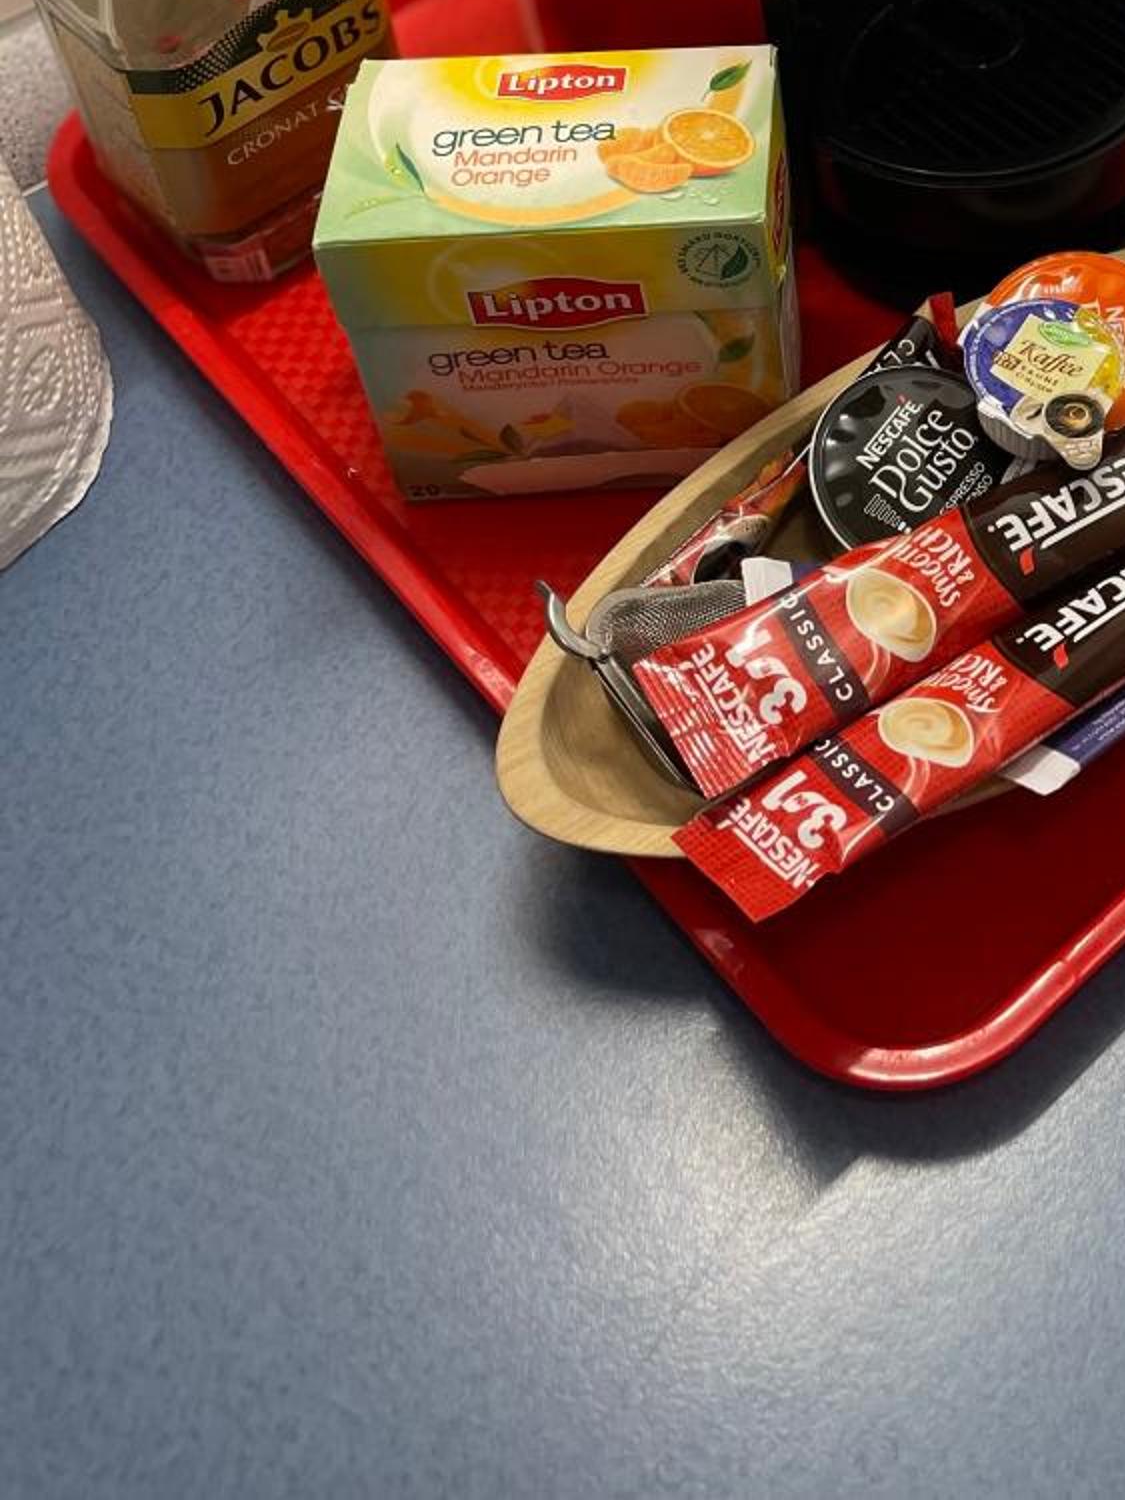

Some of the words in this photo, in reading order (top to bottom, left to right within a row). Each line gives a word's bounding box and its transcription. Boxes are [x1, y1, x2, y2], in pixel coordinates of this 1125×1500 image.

[198, 1, 382, 137] JACOBS
[508, 73, 617, 95] Lipton
[227, 101, 319, 166] CRONAT
[432, 124, 543, 158] green
[551, 120, 617, 143] tea
[453, 145, 577, 168] Mandarin
[451, 167, 550, 188] Orange
[483, 290, 633, 321] Lipton
[428, 345, 537, 377] green
[543, 340, 610, 362] tea
[457, 362, 591, 385] Mandarin
[596, 358, 703, 379] Orange
[1018, 338, 1085, 378] Kaffee
[869, 409, 953, 500] Dolce
[899, 428, 976, 512] Gusto
